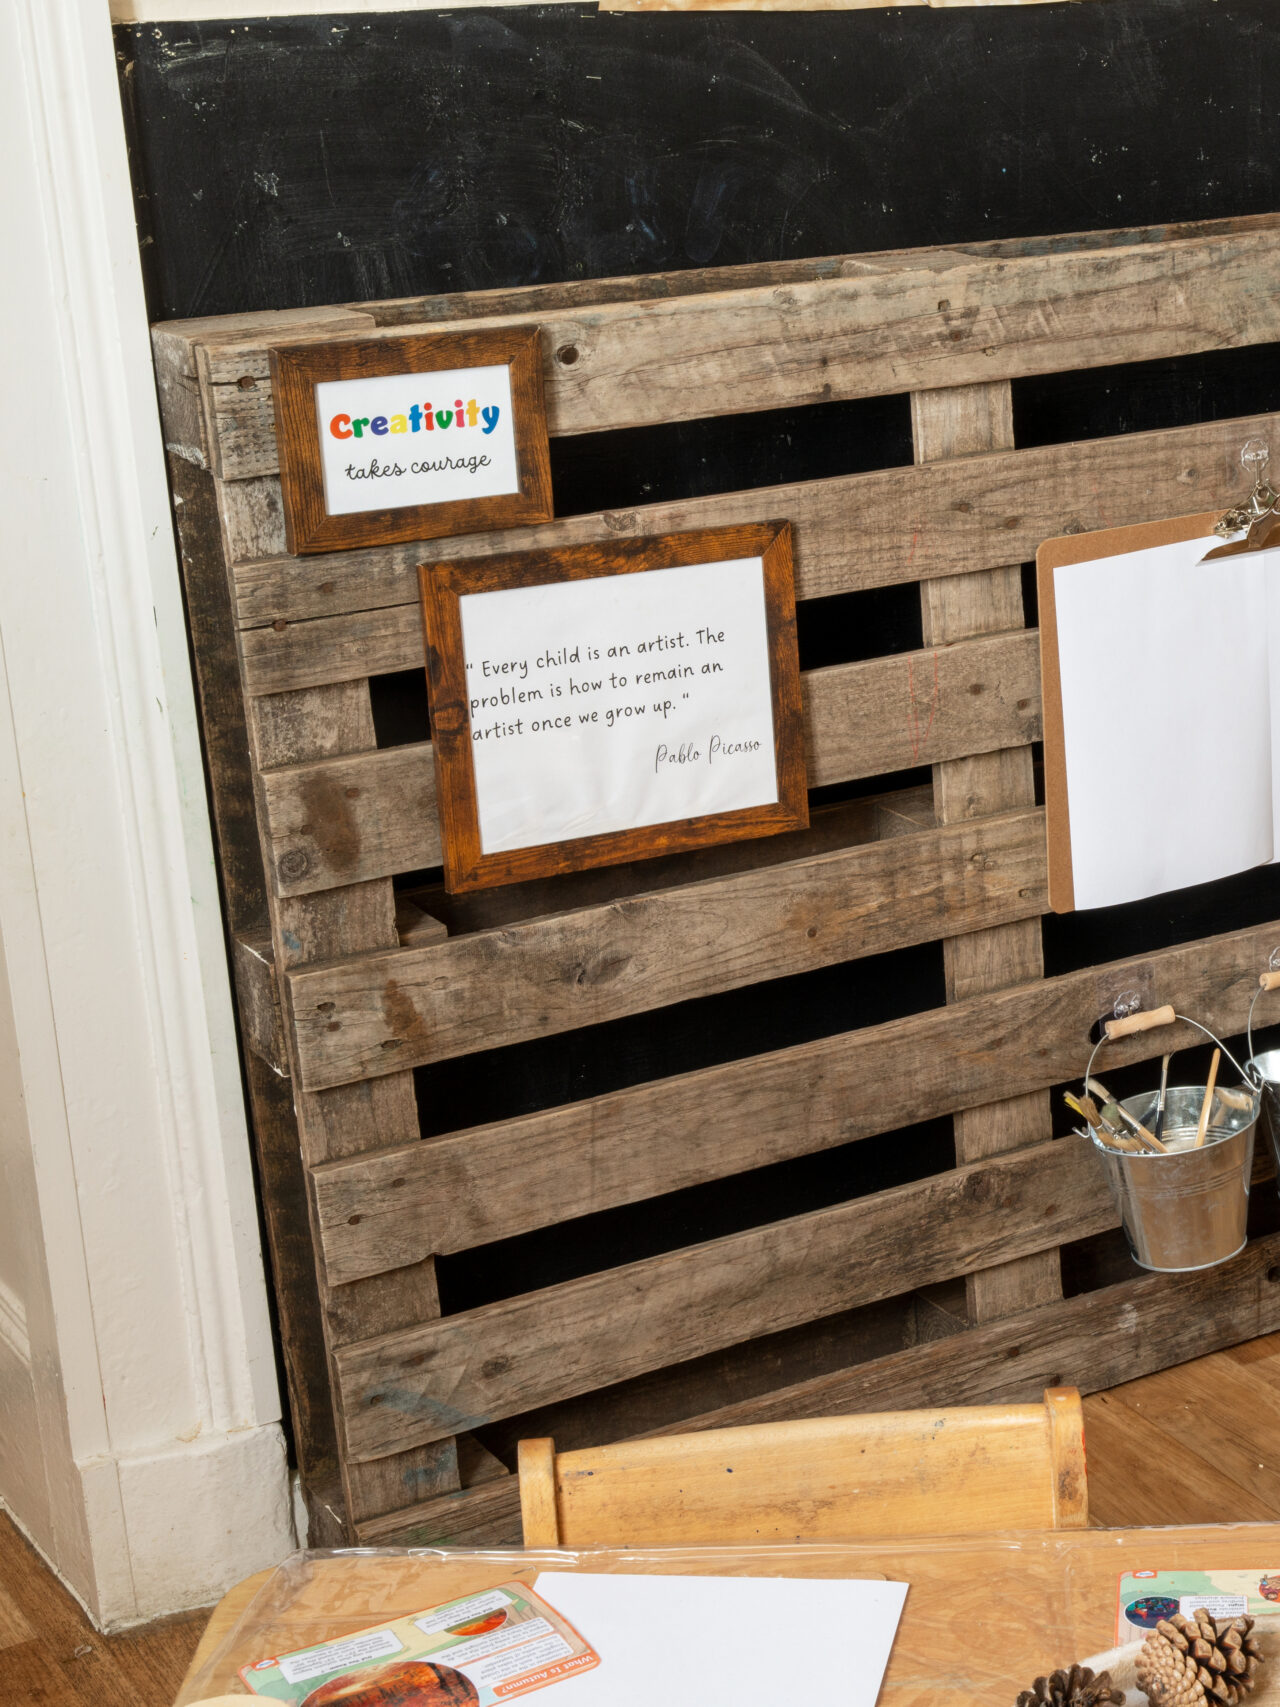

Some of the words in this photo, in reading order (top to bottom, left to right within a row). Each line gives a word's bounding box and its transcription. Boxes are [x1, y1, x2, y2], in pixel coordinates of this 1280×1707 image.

[329, 399, 500, 440] Creativity
[344, 458, 407, 480] takes
[410, 454, 492, 474] courage
[536, 647, 580, 668] child
[588, 646, 600, 660] is
[607, 645, 630, 658] an
[637, 632, 689, 653] artist.
[696, 627, 725, 645] The
[470, 687, 543, 718] problem
[550, 684, 561, 698] is
[569, 678, 602, 696] how
[609, 673, 627, 689] to
[636, 664, 694, 685] remain
[701, 660, 723, 675] an
[472, 720, 523, 741] artist
[532, 716, 571, 732] once
[579, 708, 599, 723] we
[605, 704, 646, 727] grow
[655, 744, 702, 773] Pablo
[709, 735, 761, 764] Picasso
[563, 1655, 593, 1669] What
[502, 1672, 548, 1693] Autumn?
